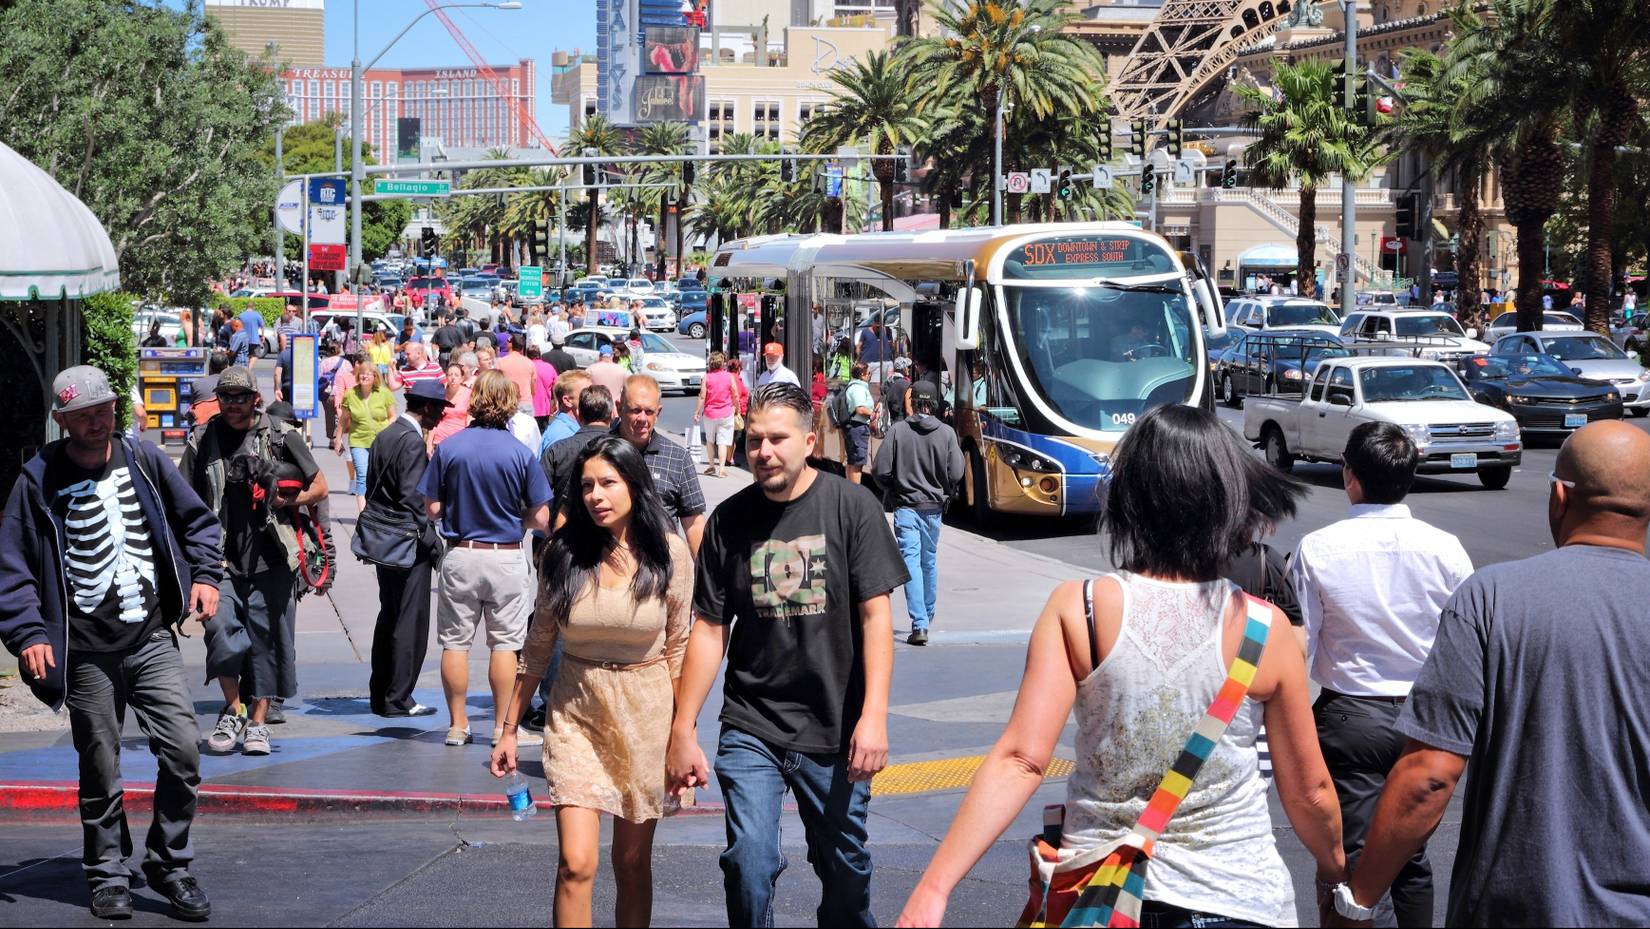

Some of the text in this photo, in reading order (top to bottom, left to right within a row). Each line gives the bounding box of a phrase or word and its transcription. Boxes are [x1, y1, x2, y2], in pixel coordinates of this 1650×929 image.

[293, 69, 477, 79] TREASU ISLAND
[387, 183, 428, 192] Bellagio
[1024, 243, 1056, 265] SDX
[1058, 242, 1097, 253] DOWNTOWN
[1109, 240, 1130, 251] STRIP
[1065, 251, 1124, 263] EXPRESS SOUTH
[1112, 413, 1136, 425] 049
